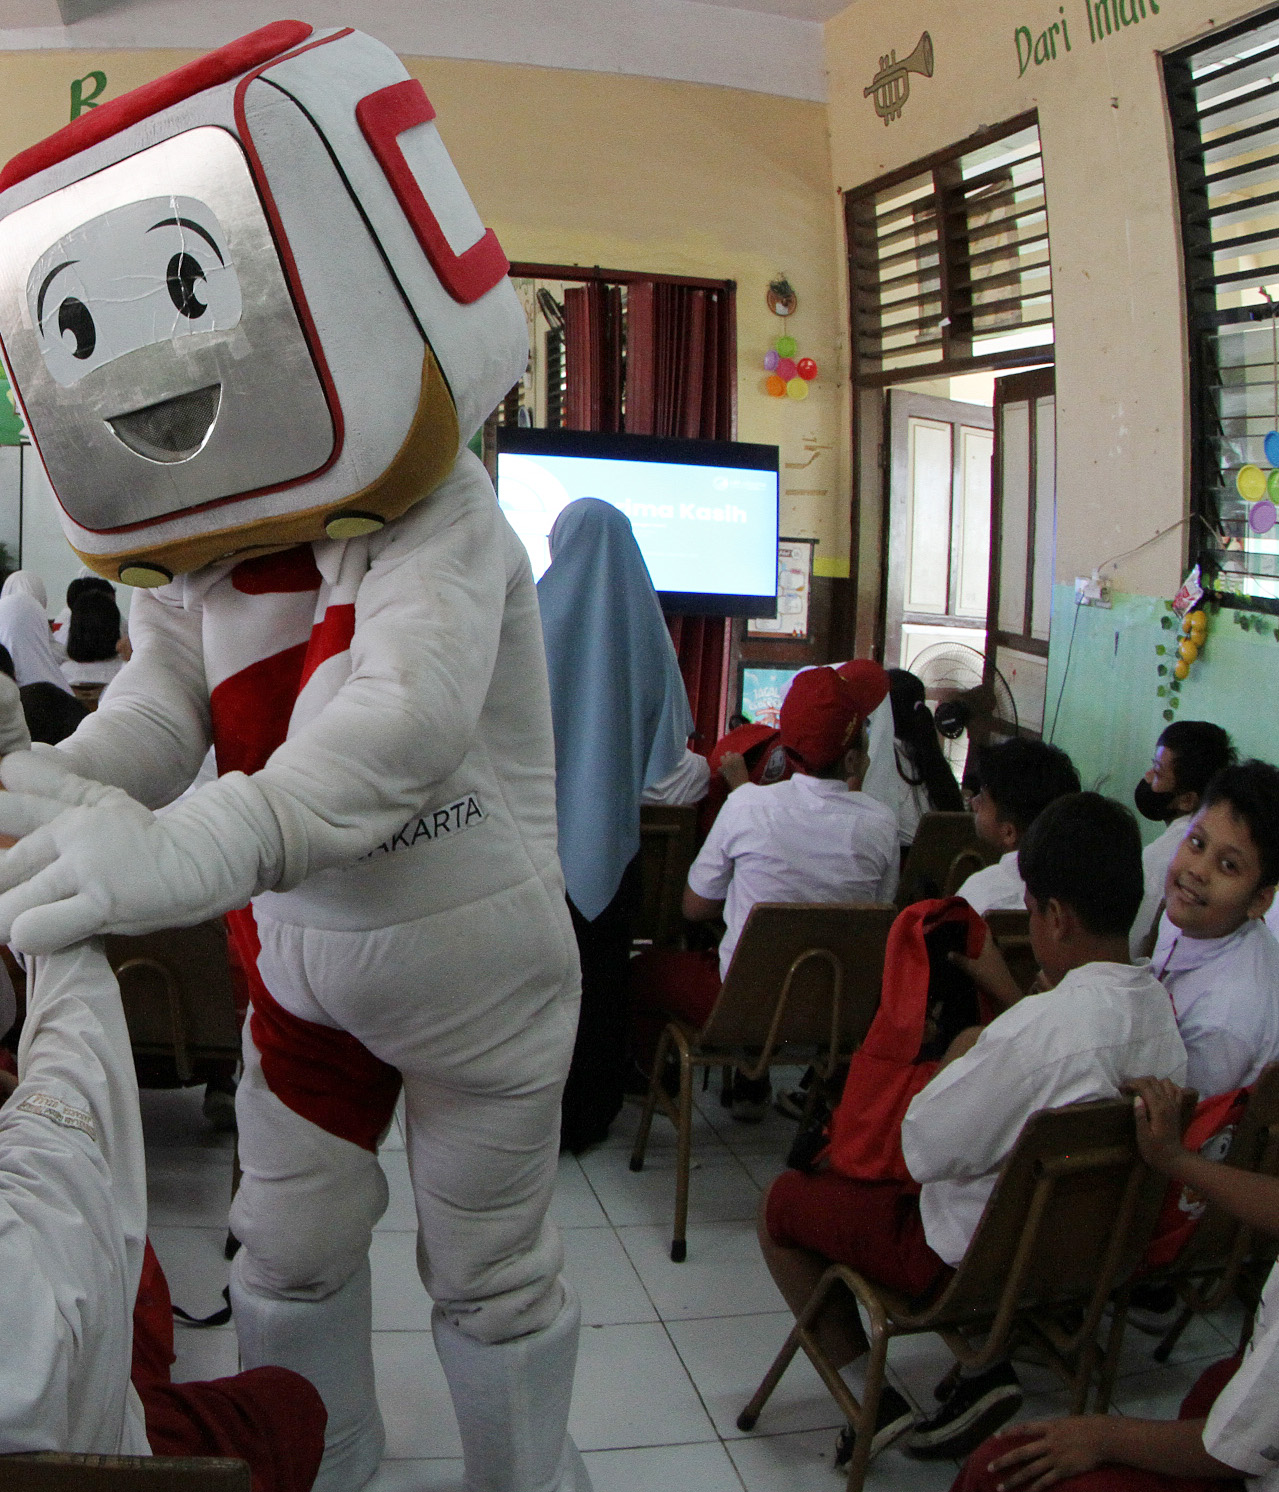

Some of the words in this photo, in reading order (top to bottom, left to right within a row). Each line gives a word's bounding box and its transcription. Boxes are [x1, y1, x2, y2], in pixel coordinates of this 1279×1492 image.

[1015, 6, 1072, 79] Dari
[679, 502, 748, 523] Kasih
[358, 797, 482, 860] KARTA
